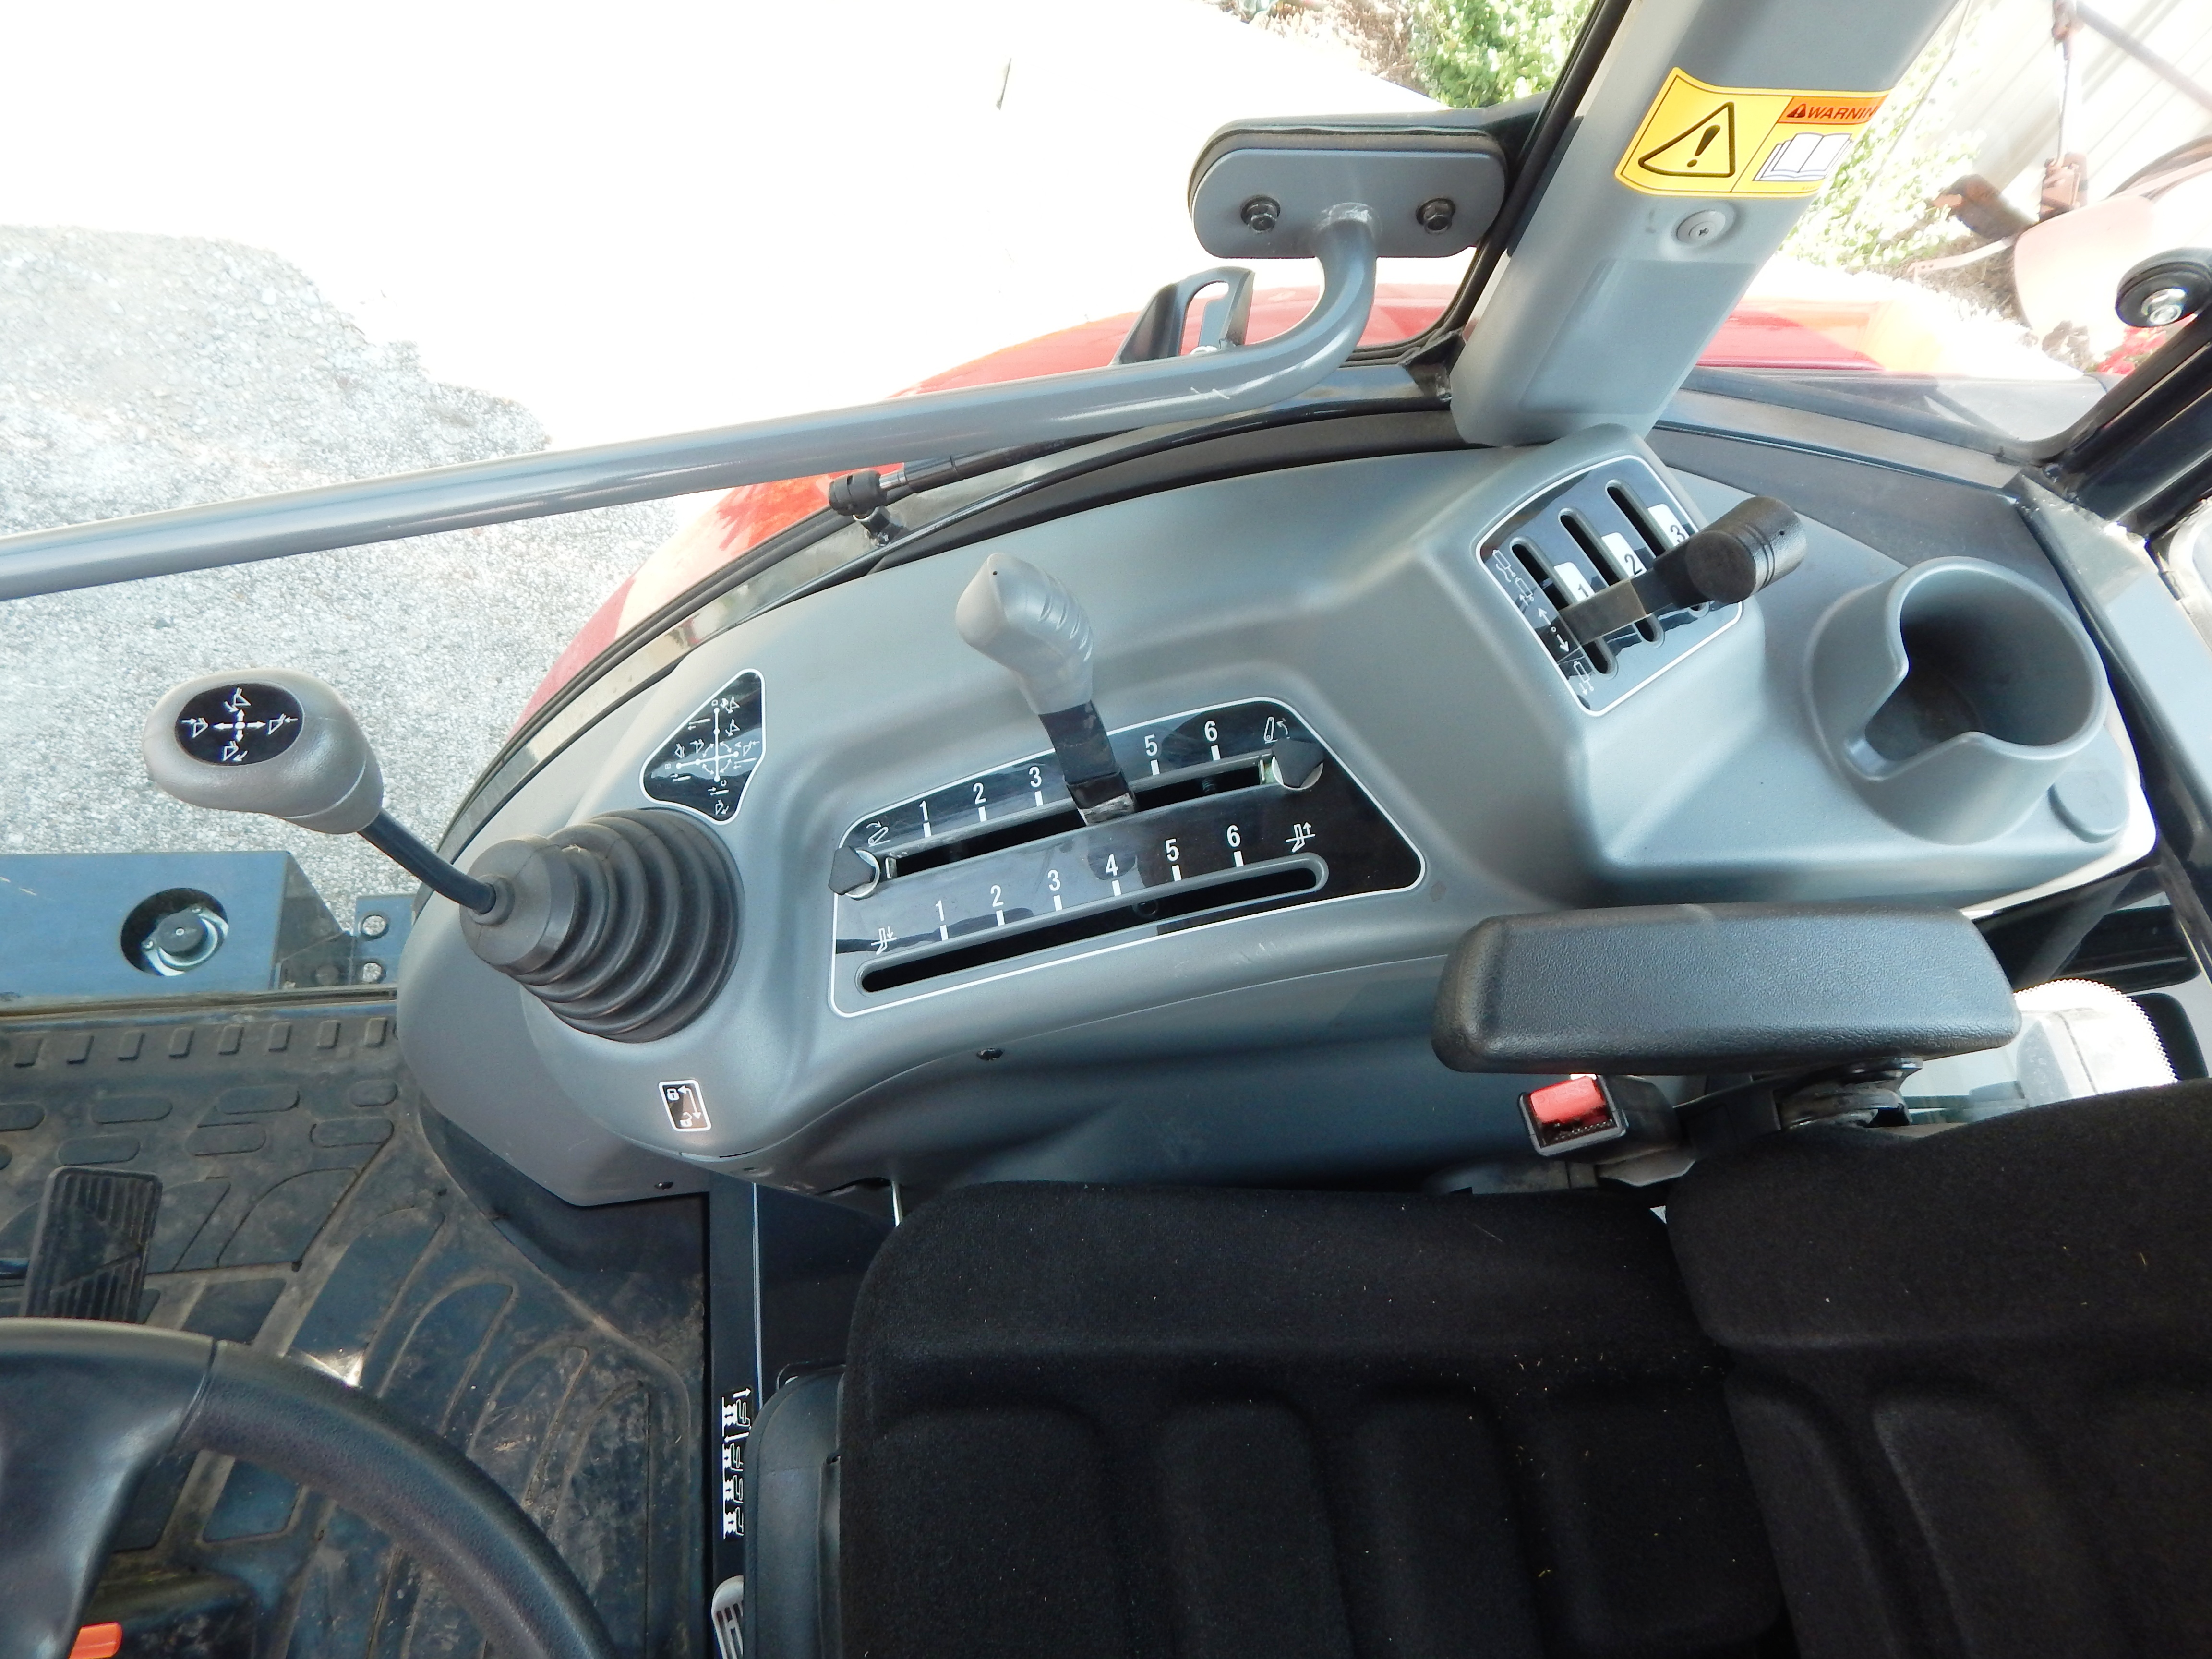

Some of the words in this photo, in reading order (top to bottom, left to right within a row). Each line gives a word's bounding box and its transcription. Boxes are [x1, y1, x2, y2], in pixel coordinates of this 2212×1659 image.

[1808, 105, 1880, 119] WARNIN
[1670, 524, 1686, 543] 3
[1624, 553, 1643, 575] 2
[1578, 584, 1589, 597] 1
[919, 800, 928, 821] 1
[973, 782, 986, 805] 2
[1029, 767, 1042, 788] 3
[1144, 734, 1158, 756] 5
[1204, 721, 1217, 742] 6
[935, 900, 945, 922] 1
[990, 885, 1004, 908] 2
[1047, 869, 1061, 892] 3
[1106, 854, 1118, 876] 4
[1165, 838, 1179, 861] 5
[1227, 825, 1240, 847] 6
